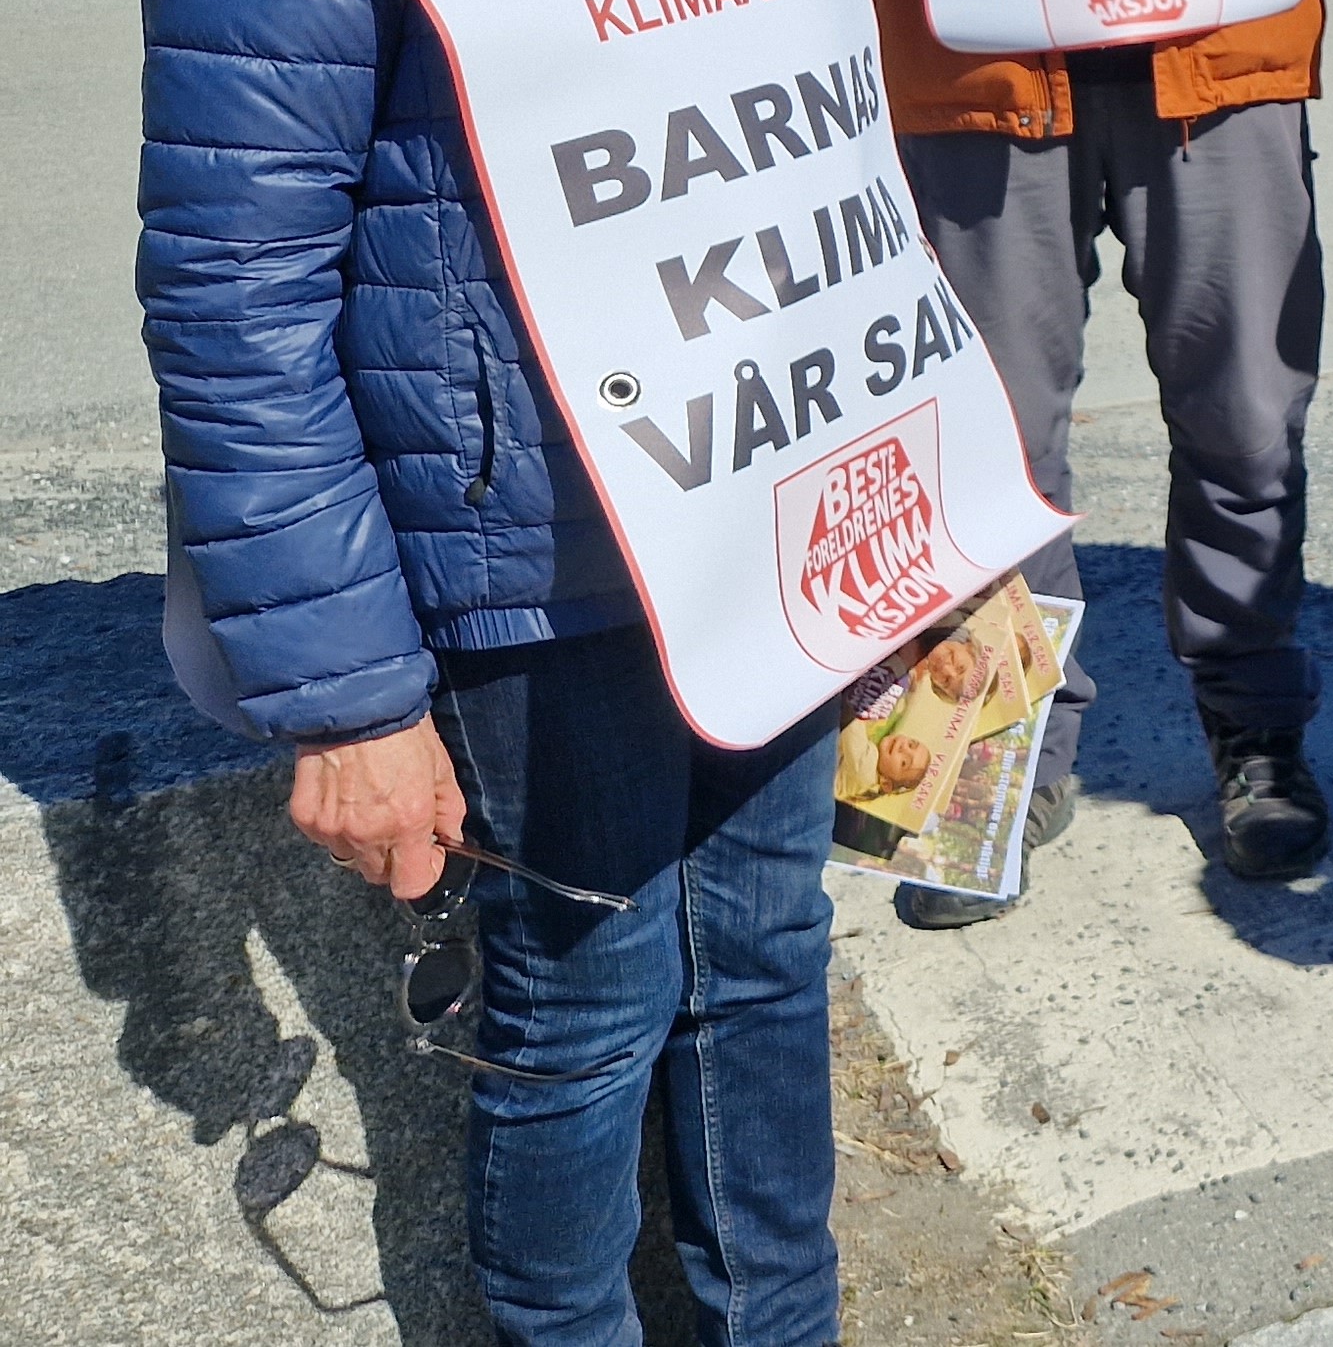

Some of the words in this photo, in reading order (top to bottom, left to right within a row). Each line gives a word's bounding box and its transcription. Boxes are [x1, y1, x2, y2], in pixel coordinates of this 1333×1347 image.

[551, 46, 881, 227] BARNAS
[655, 176, 911, 341] KLIMA
[618, 347, 844, 492] VÅR
[863, 273, 975, 397] SAK
[806, 467, 920, 575] FORELDRENES
[824, 443, 898, 524] BESTE
[808, 506, 932, 616] KLIMA
[857, 561, 943, 641] AKSJON
